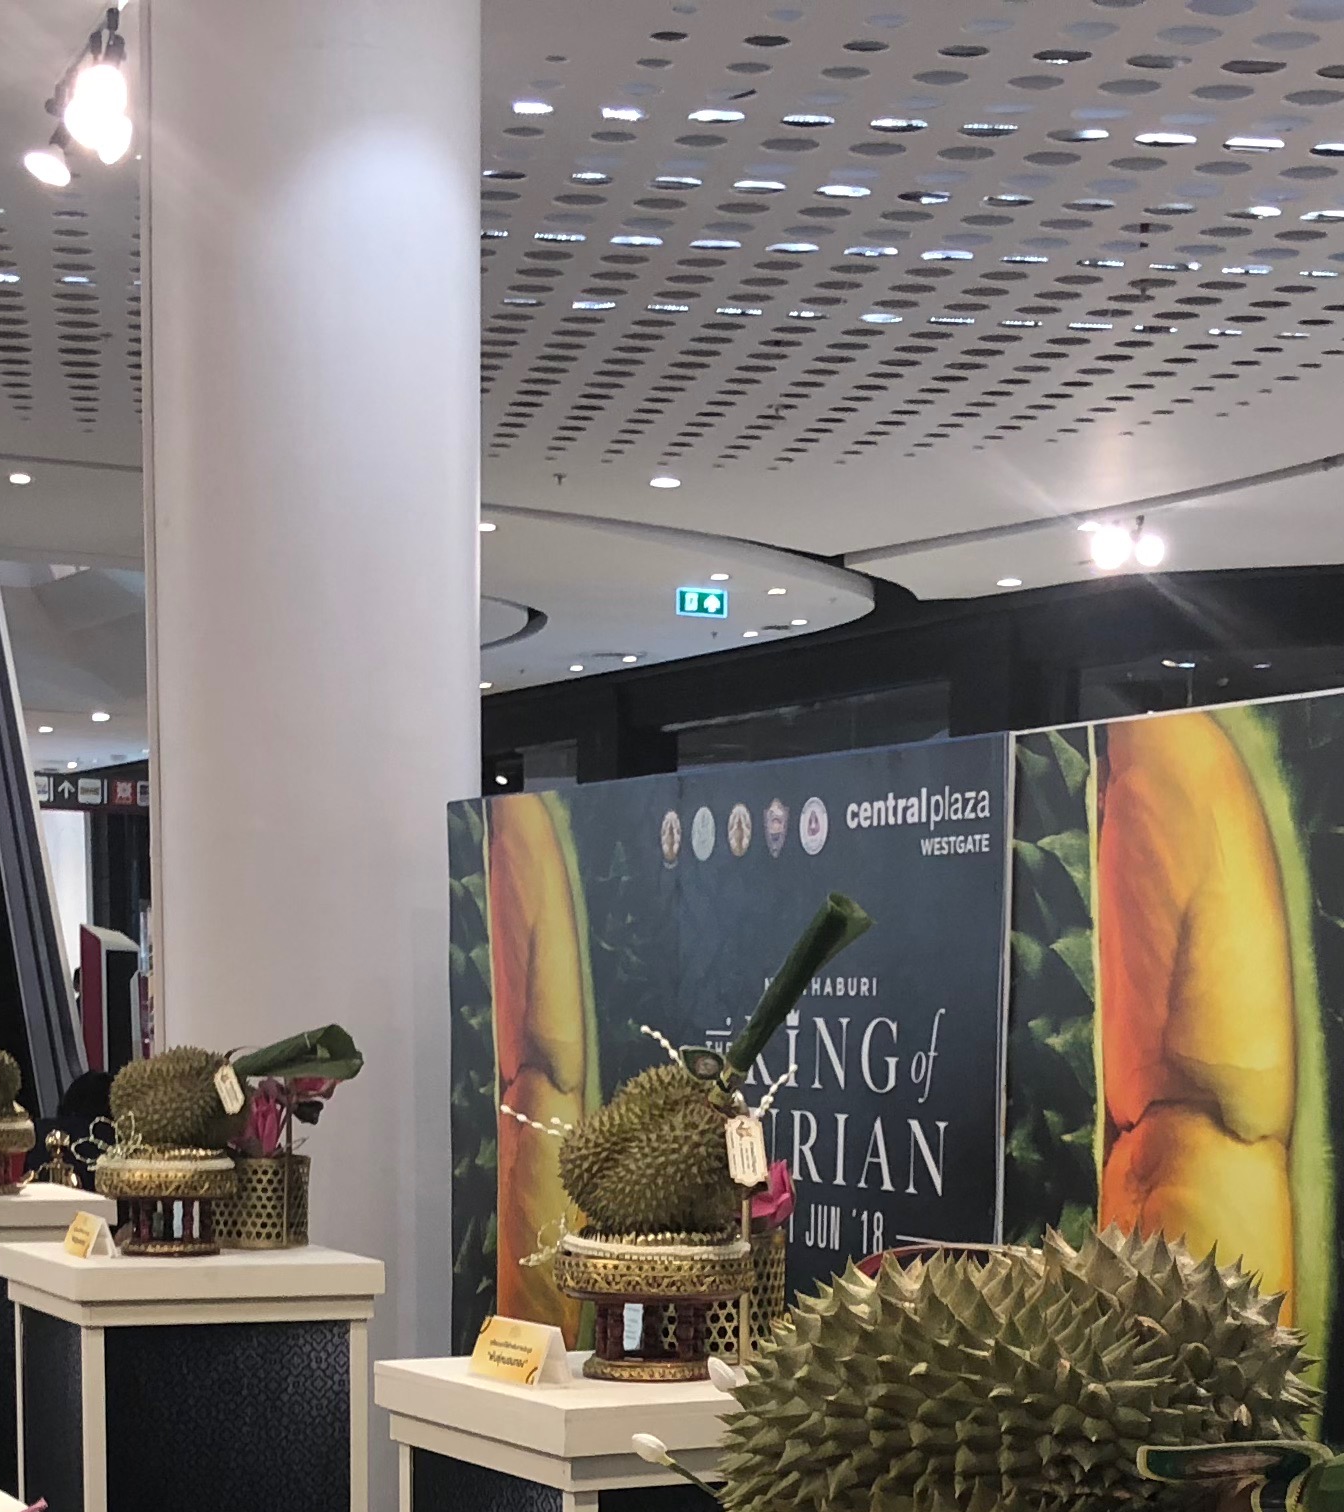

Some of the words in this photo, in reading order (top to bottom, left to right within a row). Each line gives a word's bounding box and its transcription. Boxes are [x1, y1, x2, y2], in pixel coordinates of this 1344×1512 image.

[920, 833, 991, 857] WESTGATE
[764, 977, 878, 997] NHABURI
[910, 1008, 946, 1103] of
[805, 1203, 841, 1251] JUN
